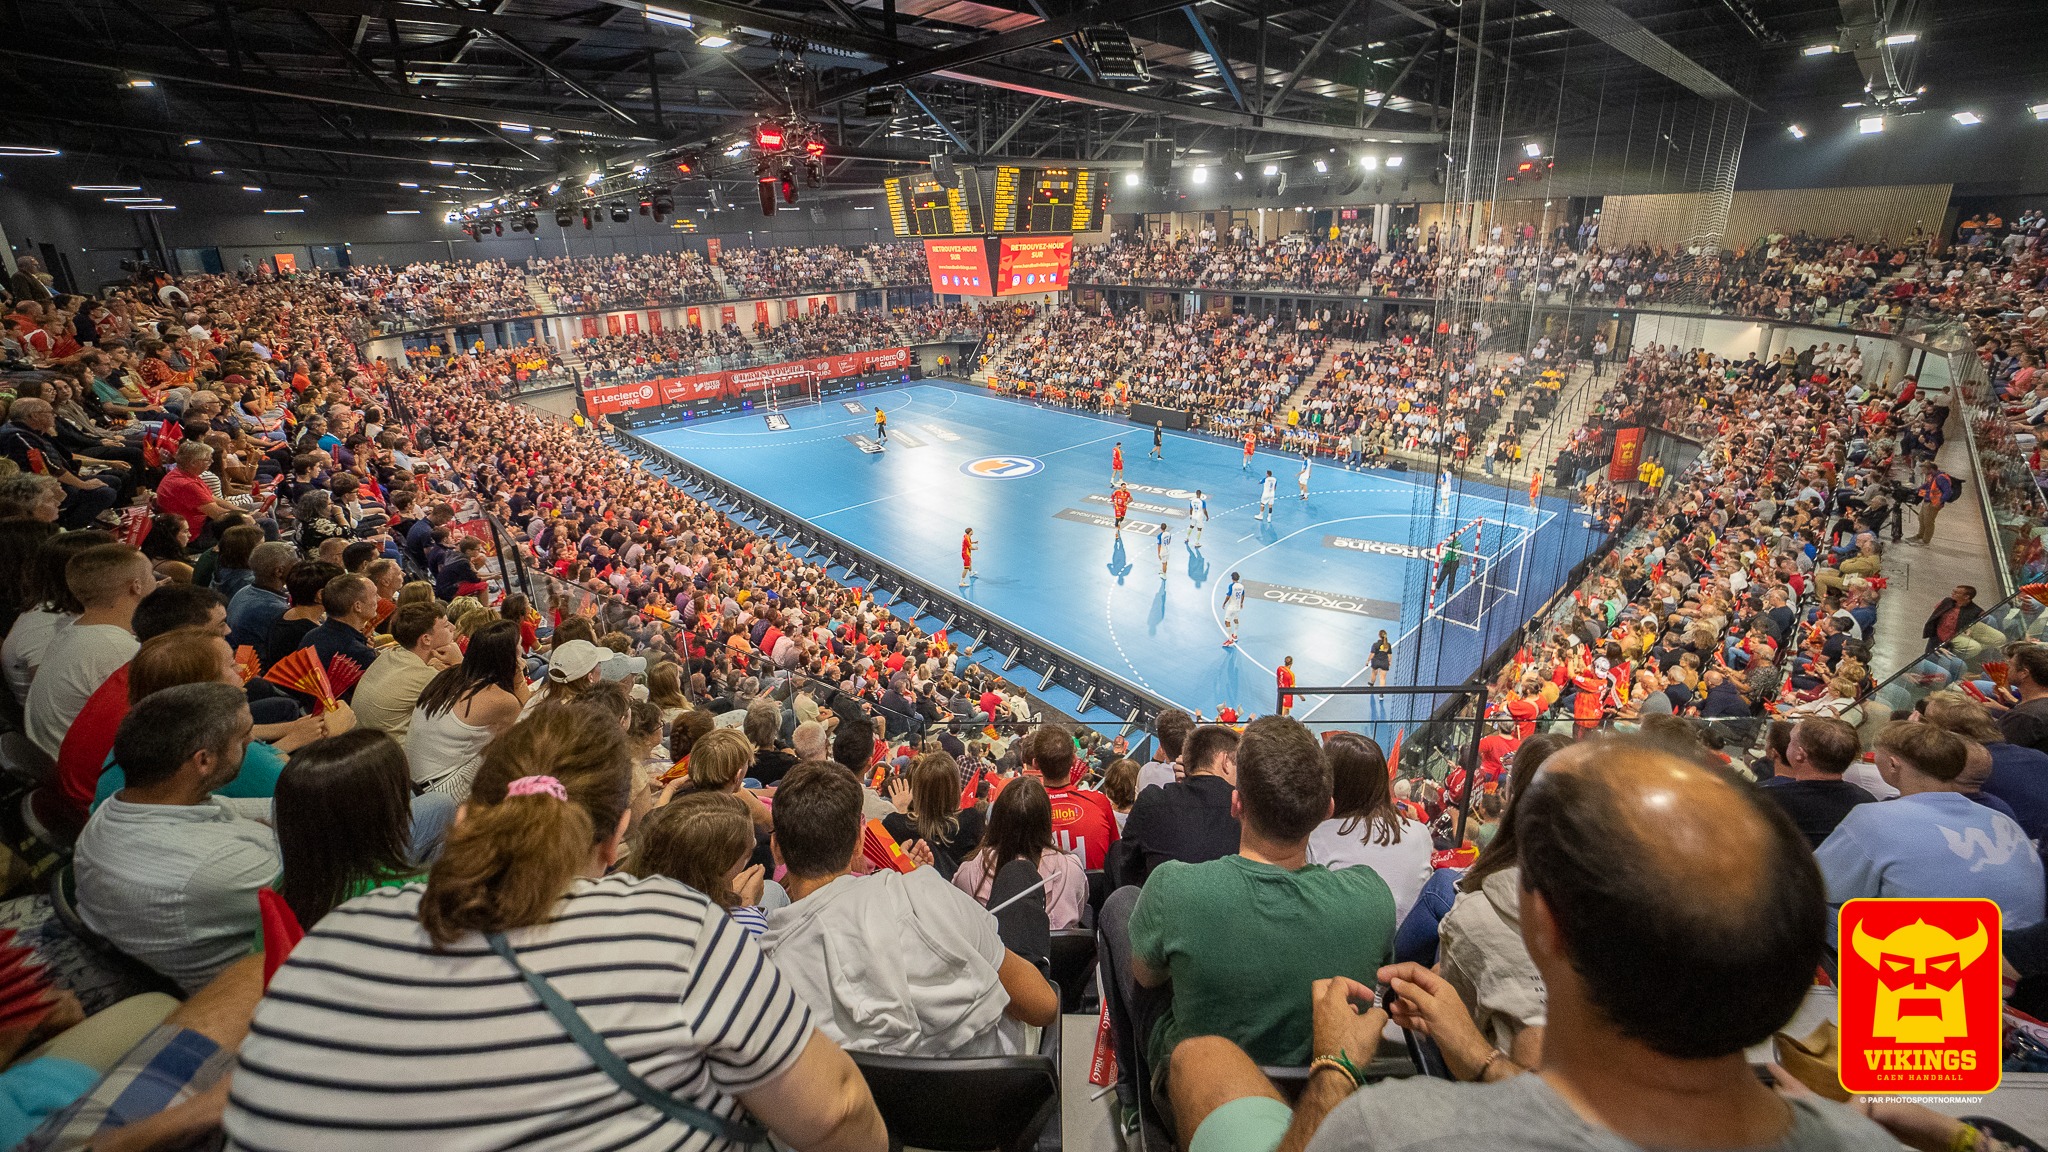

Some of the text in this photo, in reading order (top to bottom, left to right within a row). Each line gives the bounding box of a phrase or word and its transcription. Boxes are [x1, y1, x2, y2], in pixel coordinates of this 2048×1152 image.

[1011, 242, 1064, 251] RETROUVEZ-NOUS
[593, 390, 639, 404] E.Leclerc
[620, 398, 640, 407] DRIVE
[1334, 539, 1418, 558] Robine
